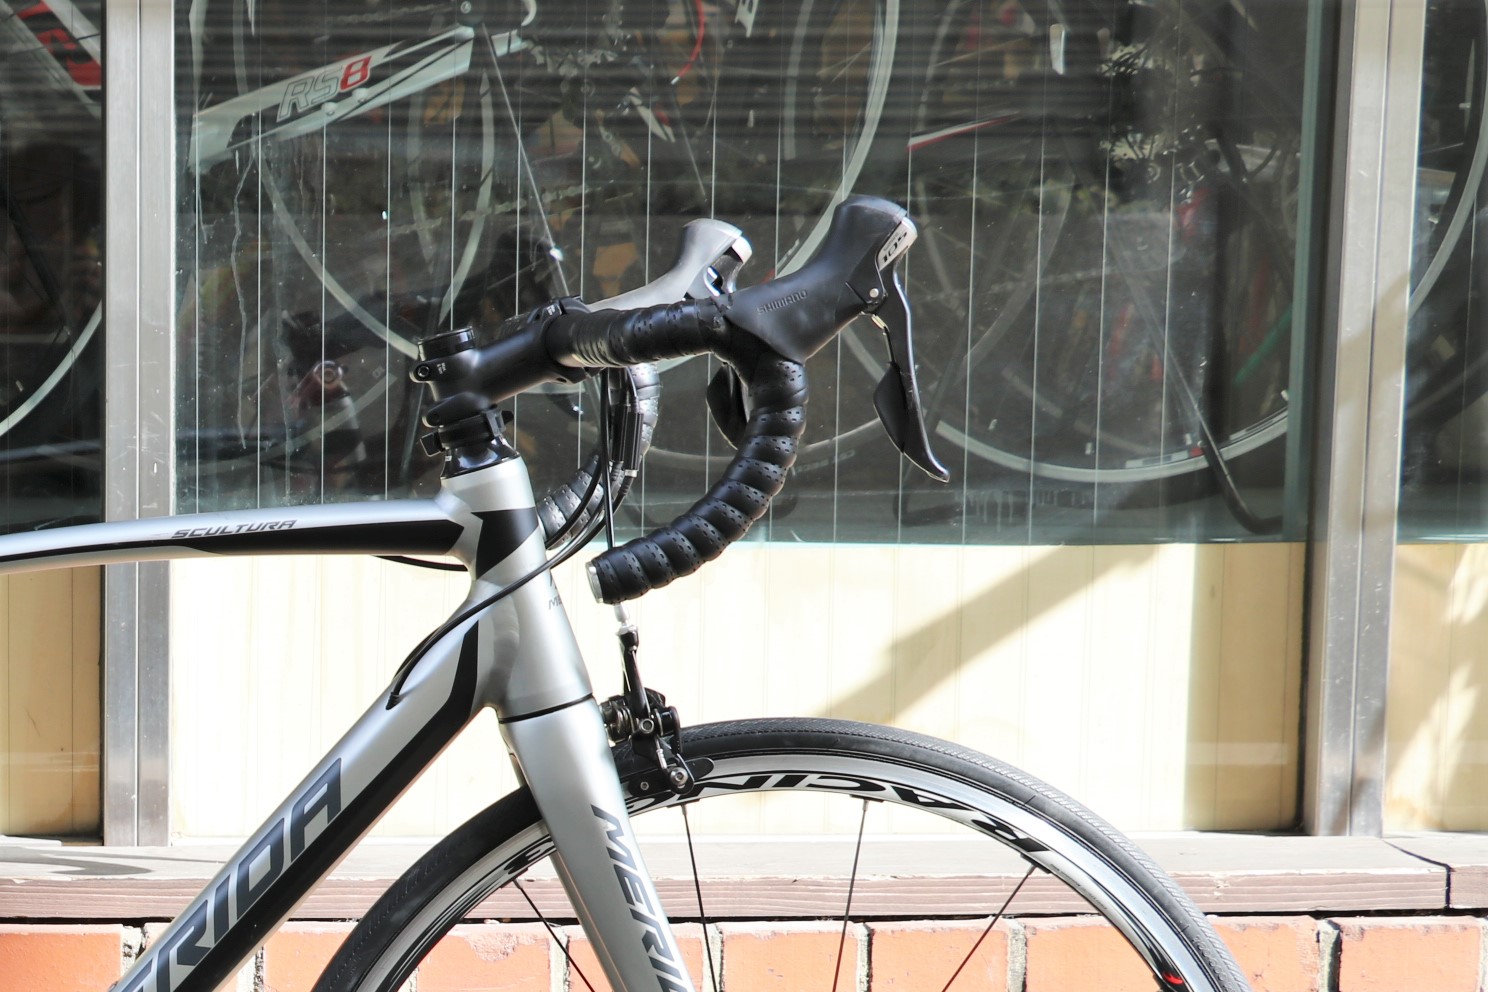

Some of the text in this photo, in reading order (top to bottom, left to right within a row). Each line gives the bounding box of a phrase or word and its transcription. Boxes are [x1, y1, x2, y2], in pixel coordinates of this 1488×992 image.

[276, 56, 372, 122] RS8
[756, 288, 809, 315] SHIMANO
[171, 519, 298, 540] SCULTURA
